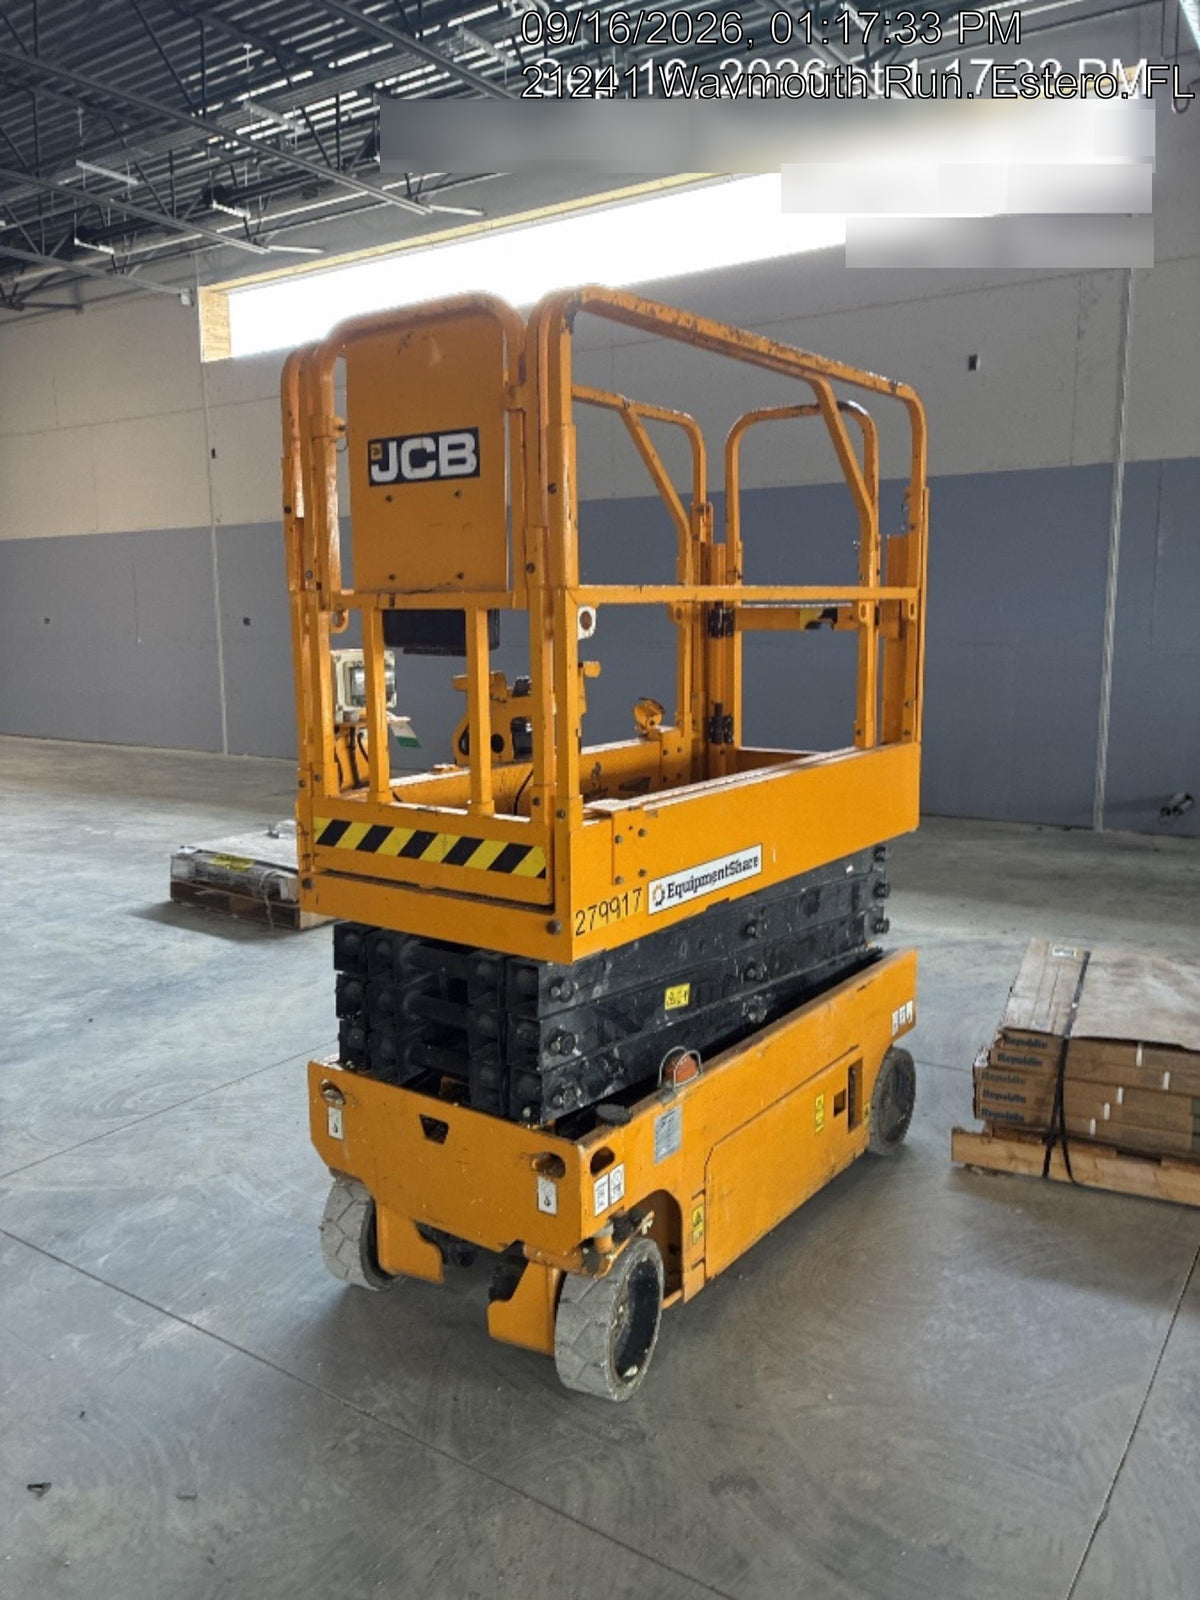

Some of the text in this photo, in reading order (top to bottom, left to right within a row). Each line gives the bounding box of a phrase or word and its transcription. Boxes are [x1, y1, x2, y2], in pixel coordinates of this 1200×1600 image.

[371, 433, 477, 482] JCB
[666, 856, 760, 899] EquipmentShare
[575, 887, 643, 937] 279917
